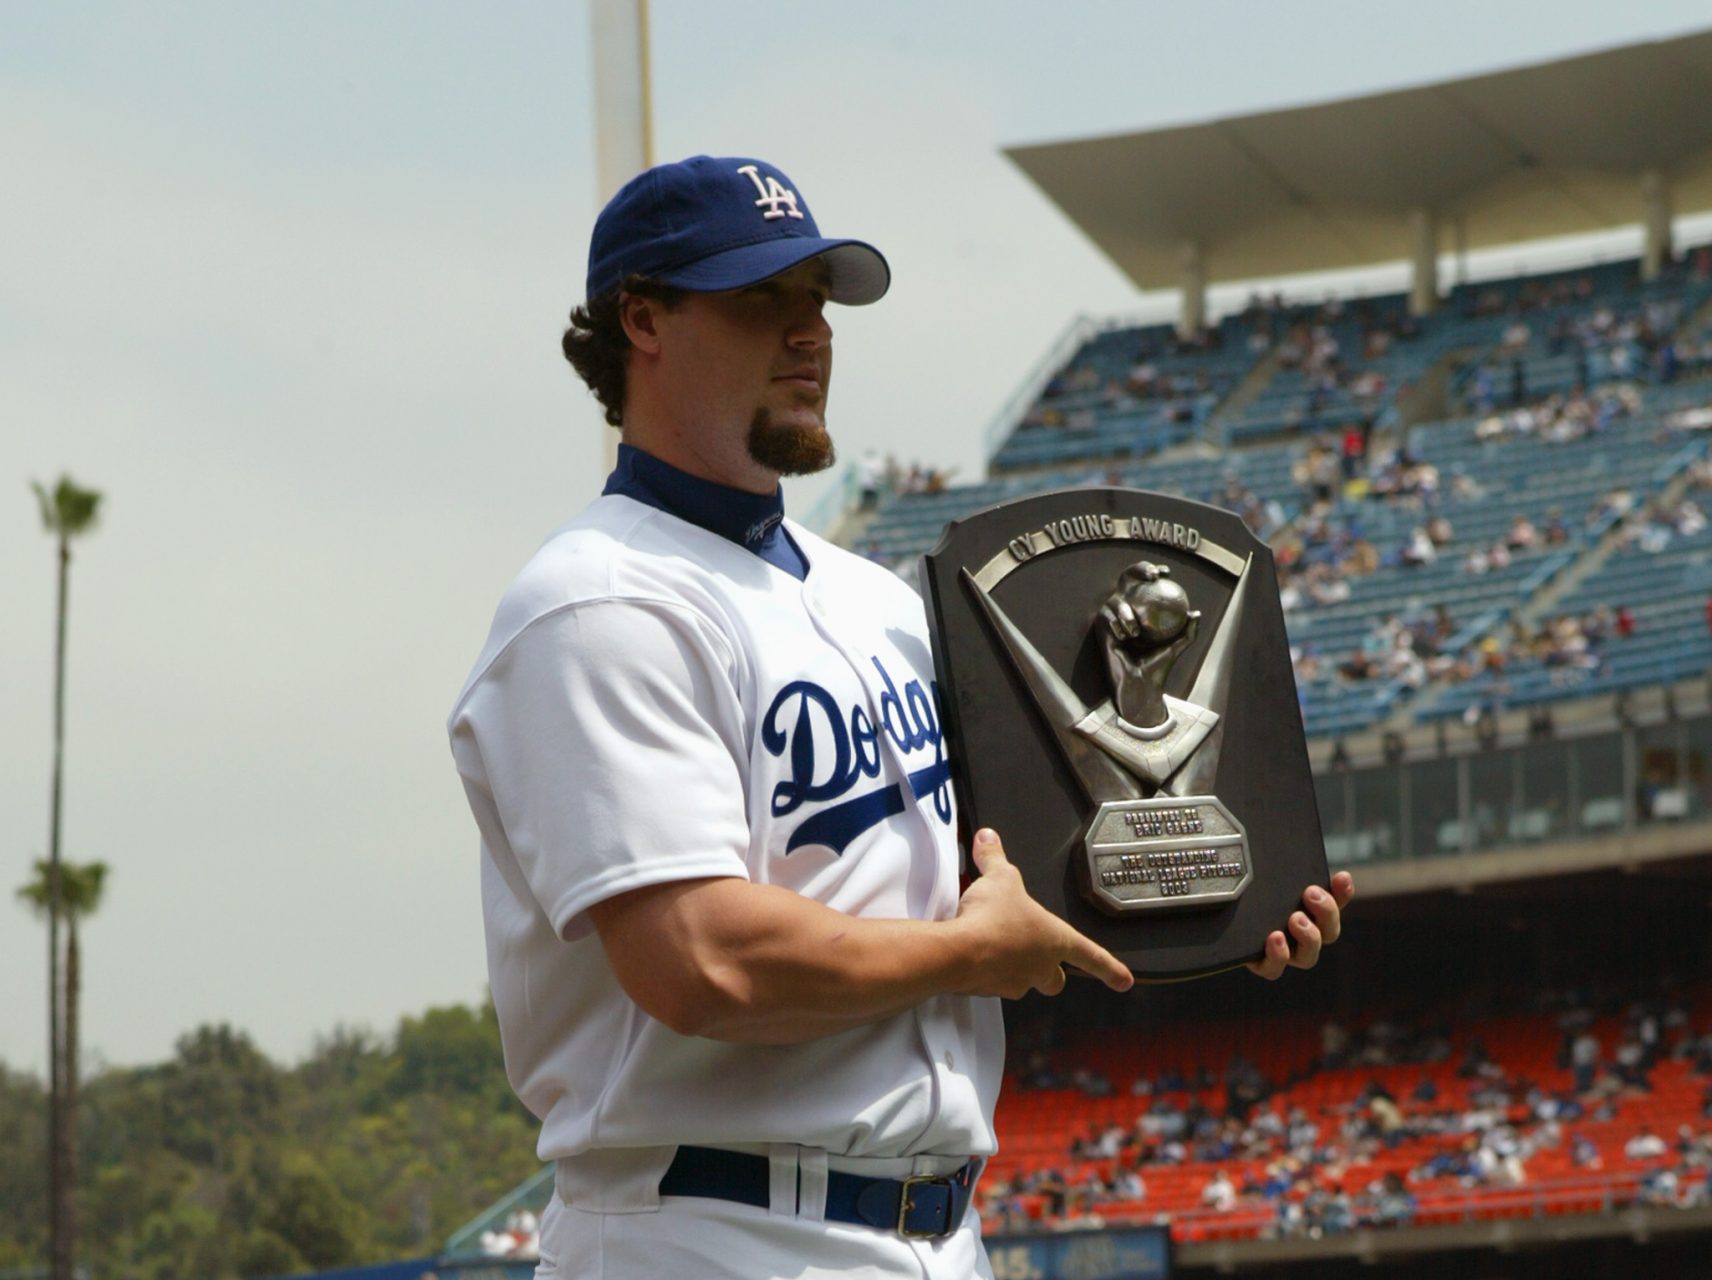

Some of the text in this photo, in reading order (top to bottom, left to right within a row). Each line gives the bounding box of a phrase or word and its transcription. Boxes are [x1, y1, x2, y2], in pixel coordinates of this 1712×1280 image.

[737, 165, 804, 219] LA
[1008, 514, 1201, 562] CY YOUNG AWARD
[1184, 808, 1199, 820] TO
[1135, 820, 1203, 837] ERIC GAGNE
[1121, 850, 1218, 868] THE OUTSTANDING
[1102, 862, 1242, 886] NATIONAL LEAGUE PITCHER
[1161, 881, 1189, 896] 2003
